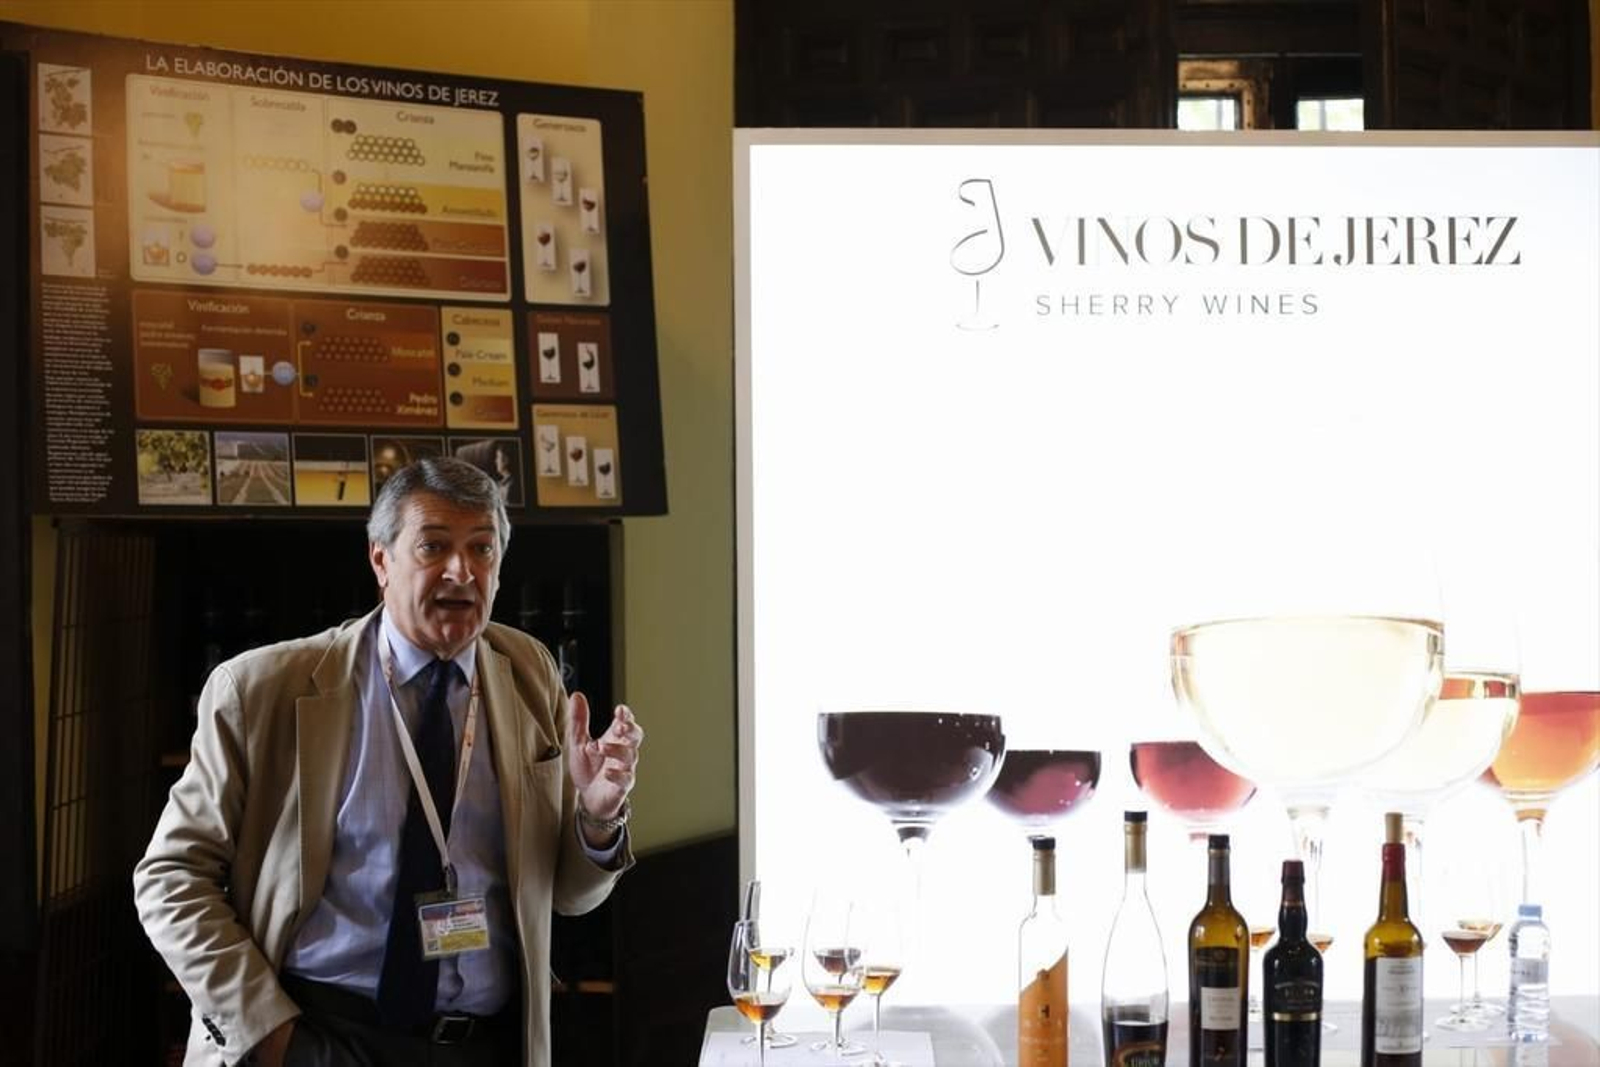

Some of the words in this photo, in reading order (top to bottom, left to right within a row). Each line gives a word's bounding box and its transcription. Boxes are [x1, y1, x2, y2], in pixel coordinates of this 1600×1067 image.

[146, 53, 169, 72] LA
[174, 57, 303, 87] ELABORACIÓN
[309, 73, 332, 90] DE
[336, 75, 369, 94] LOS
[371, 80, 424, 99] VINOS
[428, 85, 450, 101] DE
[454, 87, 499, 107] JEREZ
[1031, 216, 1220, 266] VINOS
[1239, 216, 1323, 266] DE
[1333, 216, 1521, 266] JEREZ
[346, 307, 386, 322] Crianza
[1036, 294, 1179, 316] SHERRY
[1203, 293, 1319, 315] WINES
